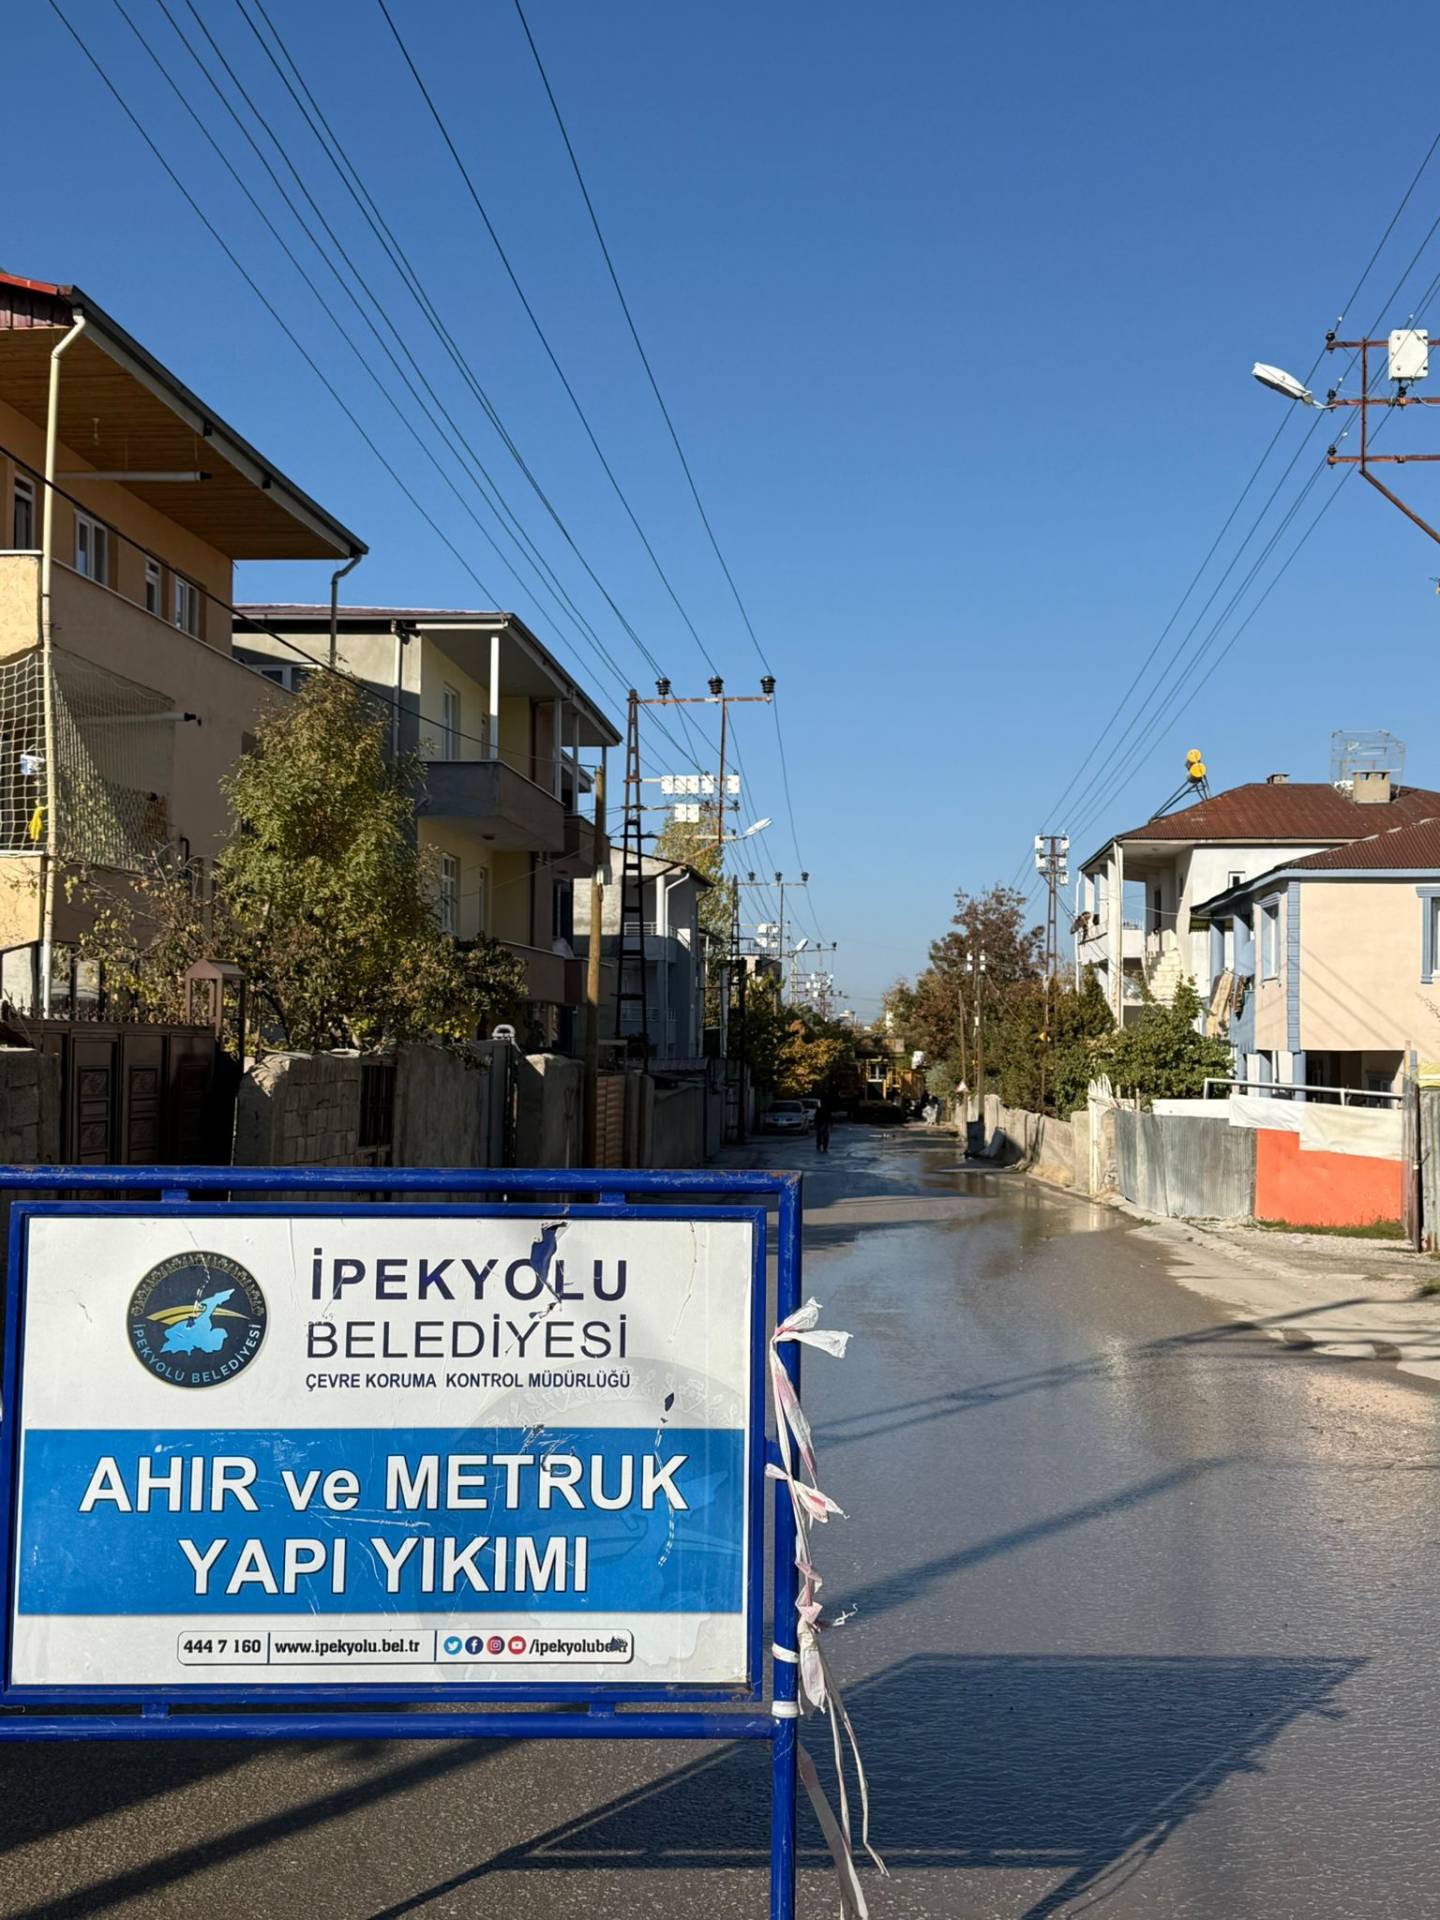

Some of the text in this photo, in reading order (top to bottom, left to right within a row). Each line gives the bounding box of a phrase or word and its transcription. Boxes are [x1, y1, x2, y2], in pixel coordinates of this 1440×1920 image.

[311, 1248, 627, 1301] İPEKYOLU
[191, 1323, 262, 1384] BELEDİYESİ
[306, 1313, 626, 1359] BELEDİYESİ
[305, 1370, 631, 1391] ÇEVRE KORUMA KONTROL MÜDÜRLÜĞÜ
[78, 1454, 690, 1513] AHIR ve METRUK
[178, 1536, 588, 1595] YAPI YIKIMI
[183, 1639, 262, 1654] 444 7 160
[274, 1639, 420, 1656] www.ipekyolu.bel.tr
